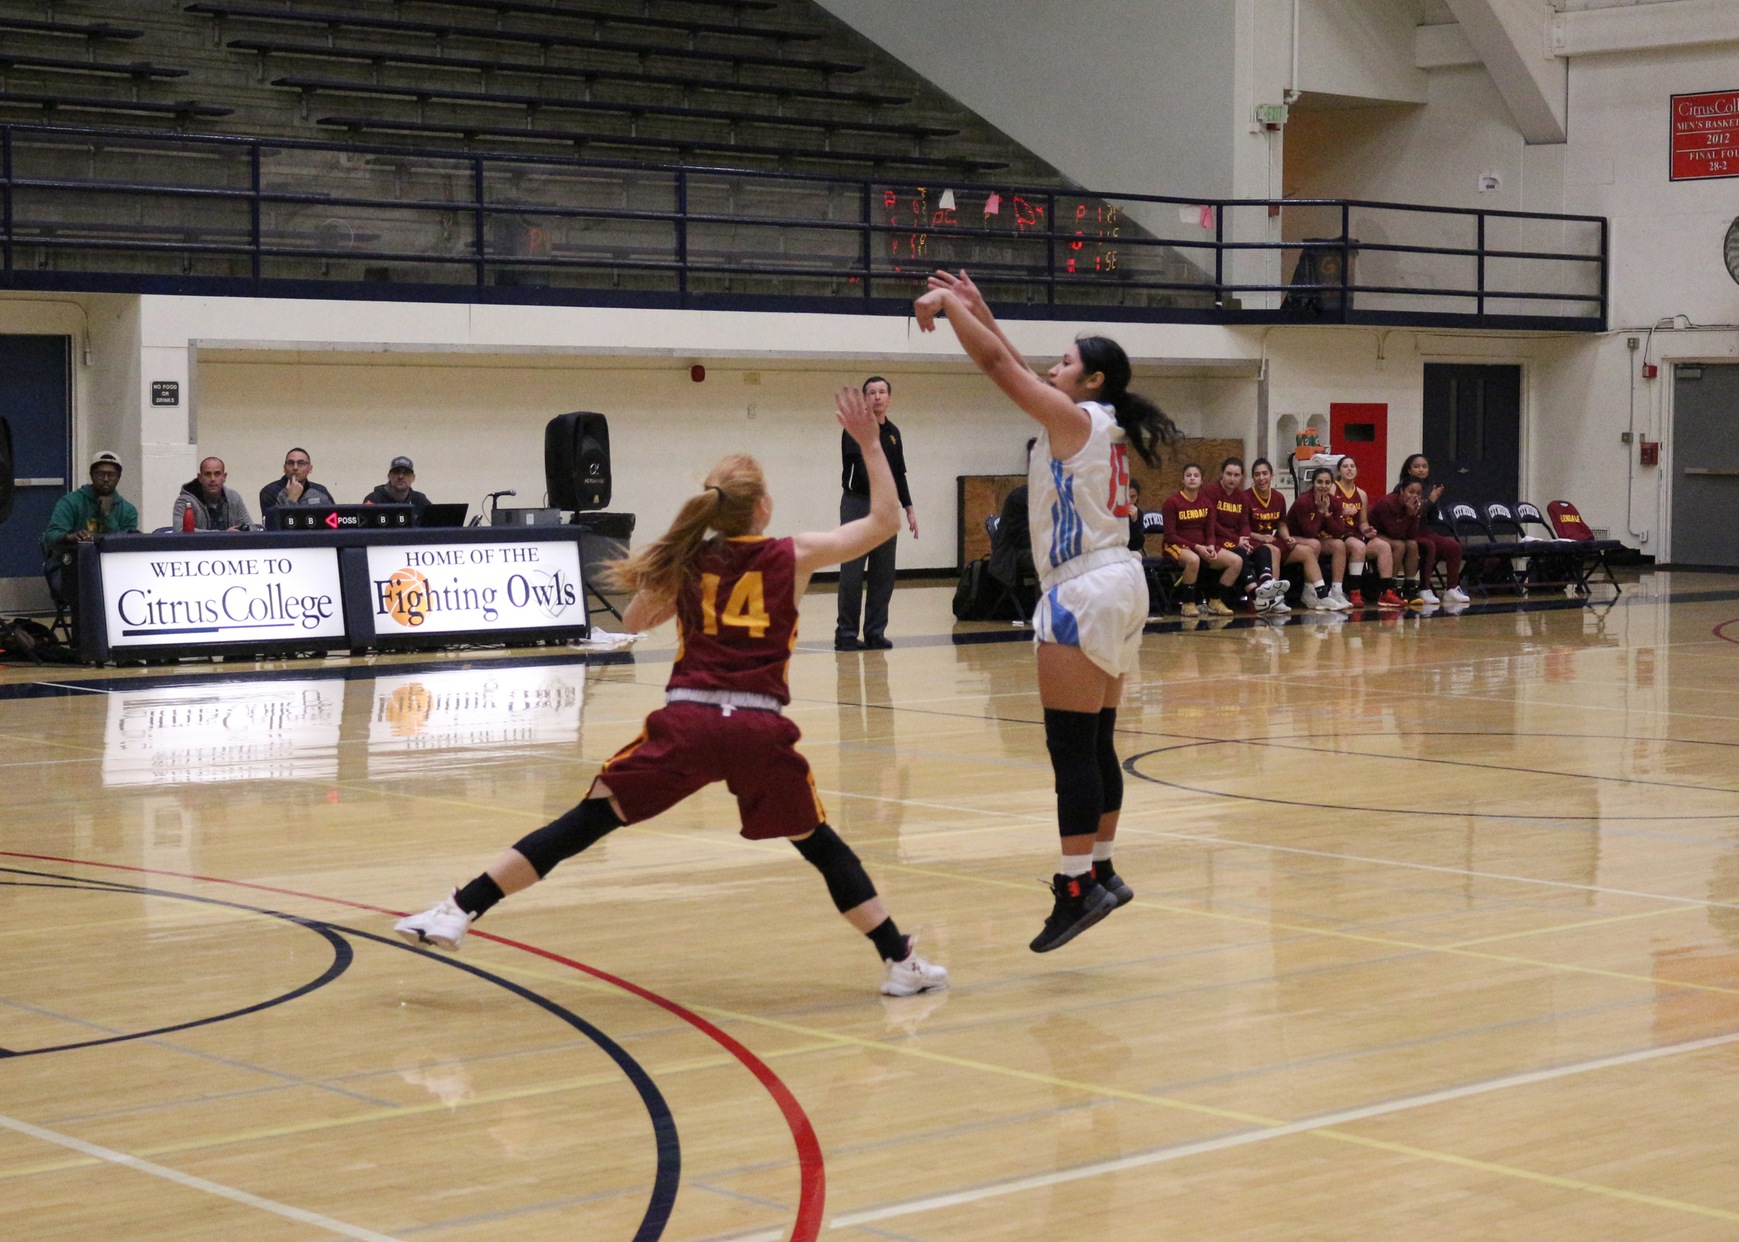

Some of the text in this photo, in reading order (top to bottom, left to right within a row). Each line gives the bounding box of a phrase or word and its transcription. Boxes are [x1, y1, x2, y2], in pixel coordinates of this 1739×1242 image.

[1676, 121, 1703, 130] MEN'S
[1706, 133, 1730, 145] 2012
[1689, 150, 1717, 161] FINAL
[1709, 161, 1727, 171] 28-2
[288, 515, 405, 525] B B POSS B B
[405, 547, 540, 567] HOME OF THE
[150, 558, 292, 578] WELCOME TO
[118, 583, 334, 629] Citrus College
[373, 570, 576, 626] Fighting Owls
[701, 570, 770, 638] 14
